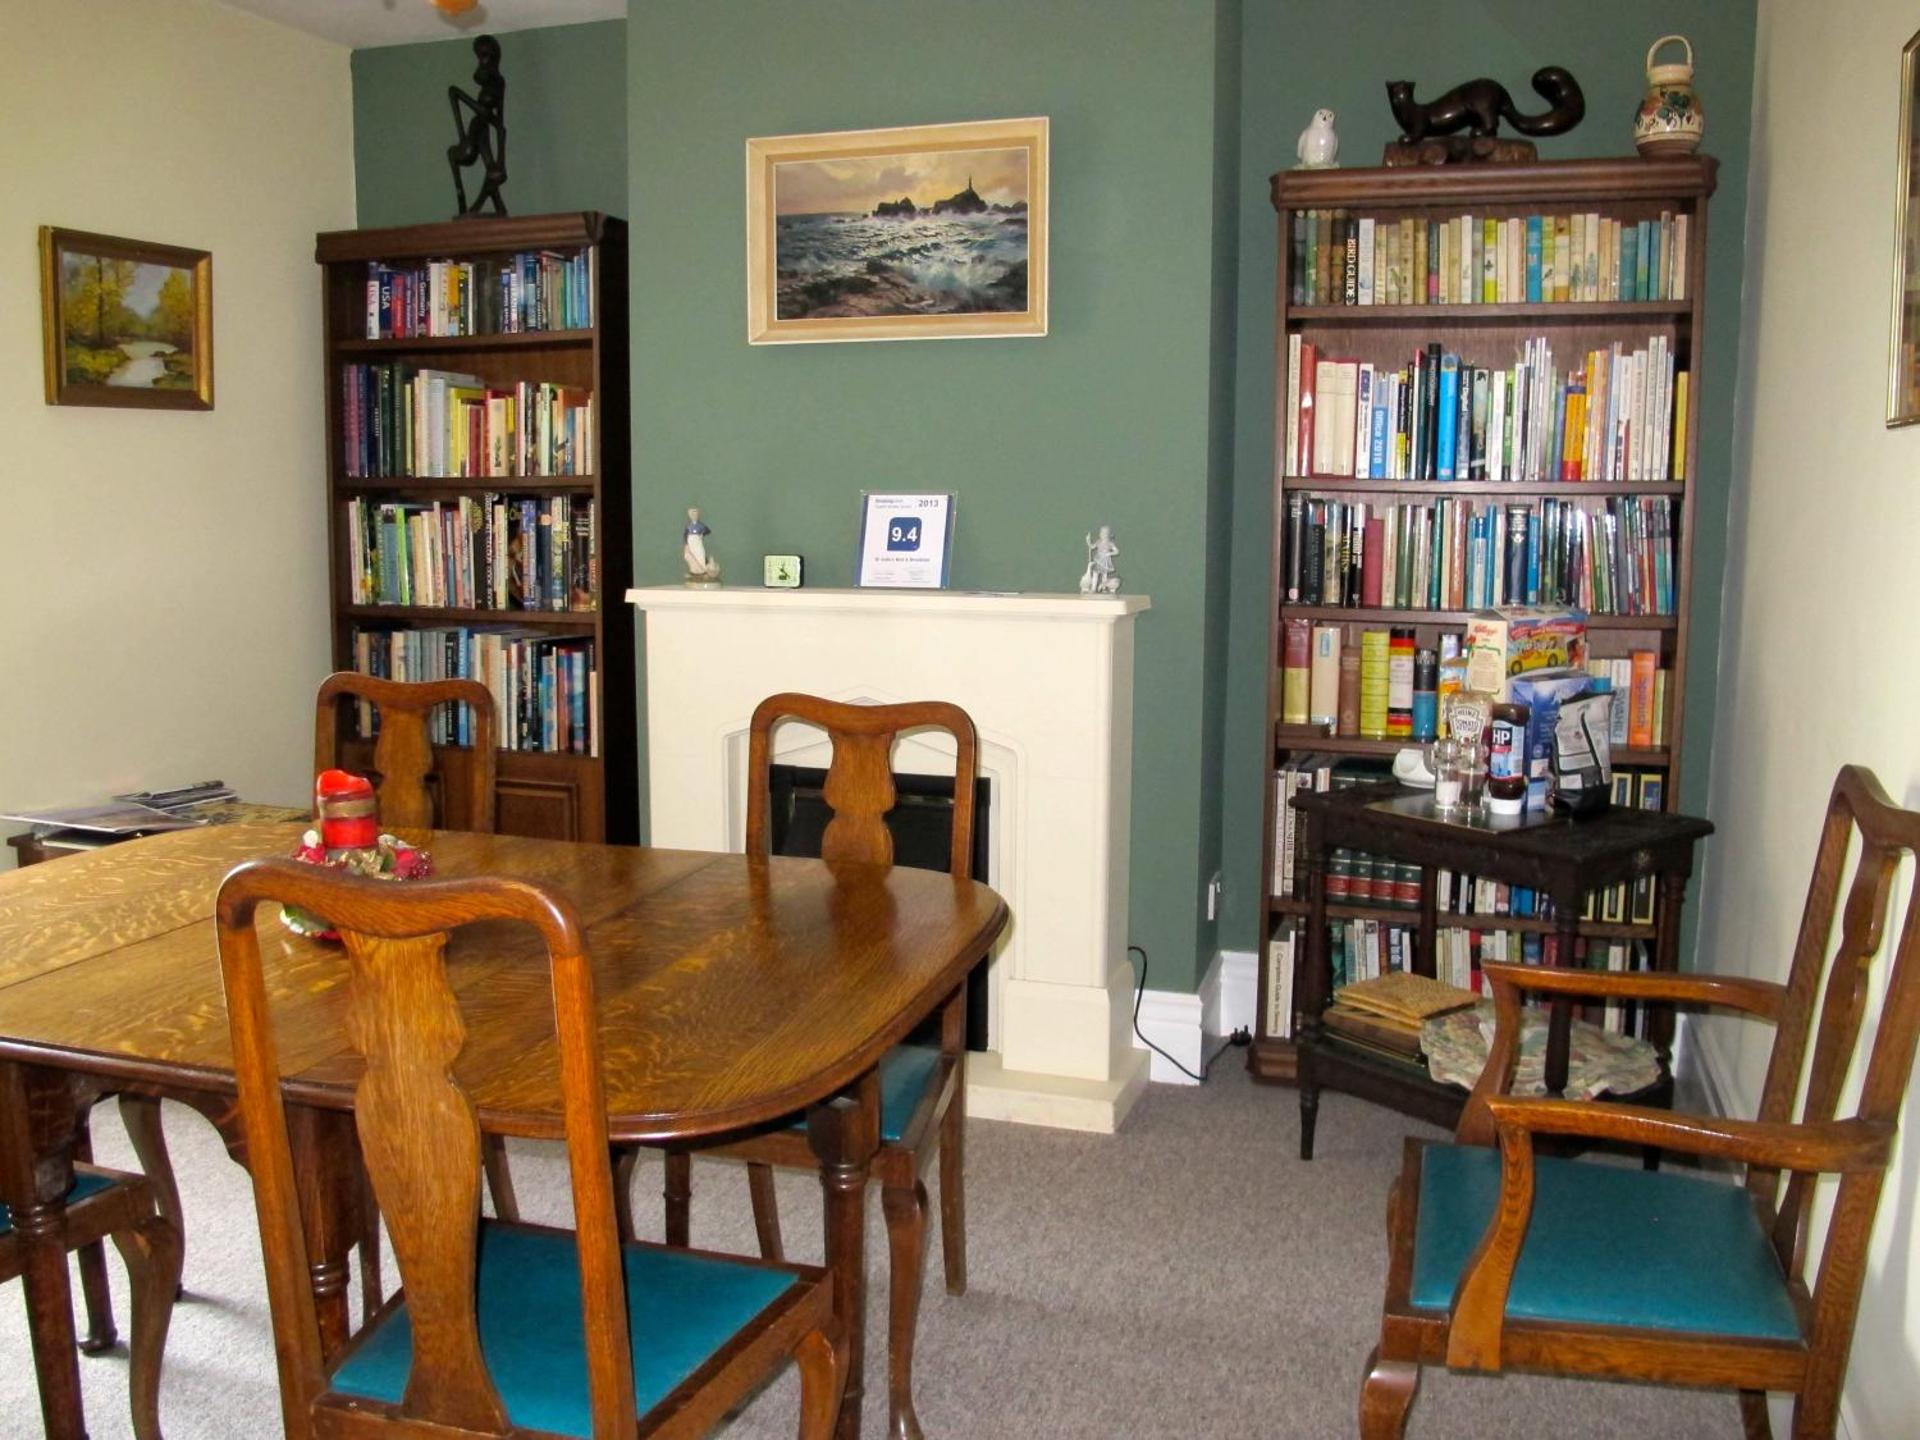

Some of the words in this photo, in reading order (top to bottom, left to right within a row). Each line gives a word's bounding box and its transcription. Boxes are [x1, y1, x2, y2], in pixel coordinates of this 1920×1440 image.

[1347, 238, 1357, 263] BIRD
[381, 285, 391, 310] USA
[417, 281, 426, 317] Germany
[1374, 410, 1384, 437] Office
[1373, 439, 1383, 464] 2010
[918, 499, 939, 508] 2013
[891, 526, 918, 542] 9.4
[1492, 729, 1511, 746] HP
[1274, 984, 1282, 1003] Guide
